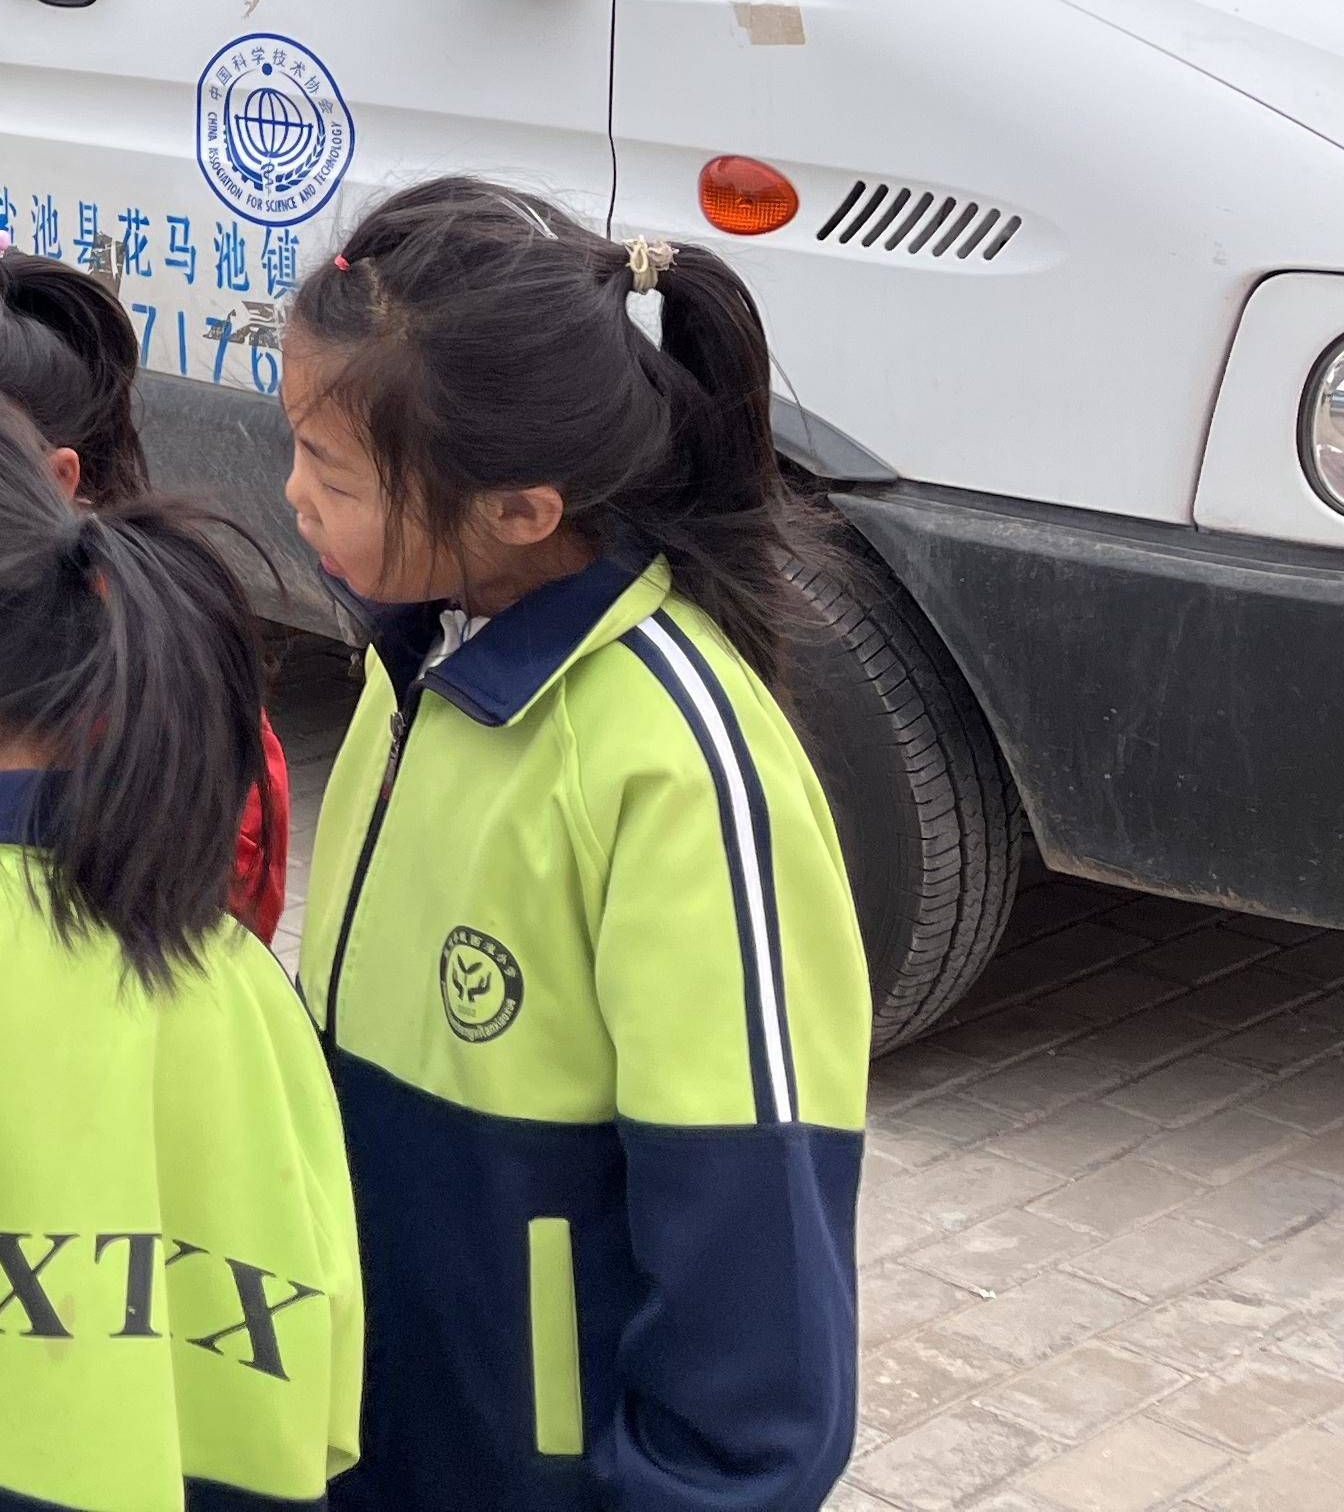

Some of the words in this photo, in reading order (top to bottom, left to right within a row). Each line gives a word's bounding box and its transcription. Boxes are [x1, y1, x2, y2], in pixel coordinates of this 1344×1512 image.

[207, 111, 218, 142] CHINA
[246, 194, 263, 209] FOR
[265, 196, 298, 213] SCIENCE
[299, 184, 317, 204] AND
[313, 121, 342, 186] TECHNOLOGY
